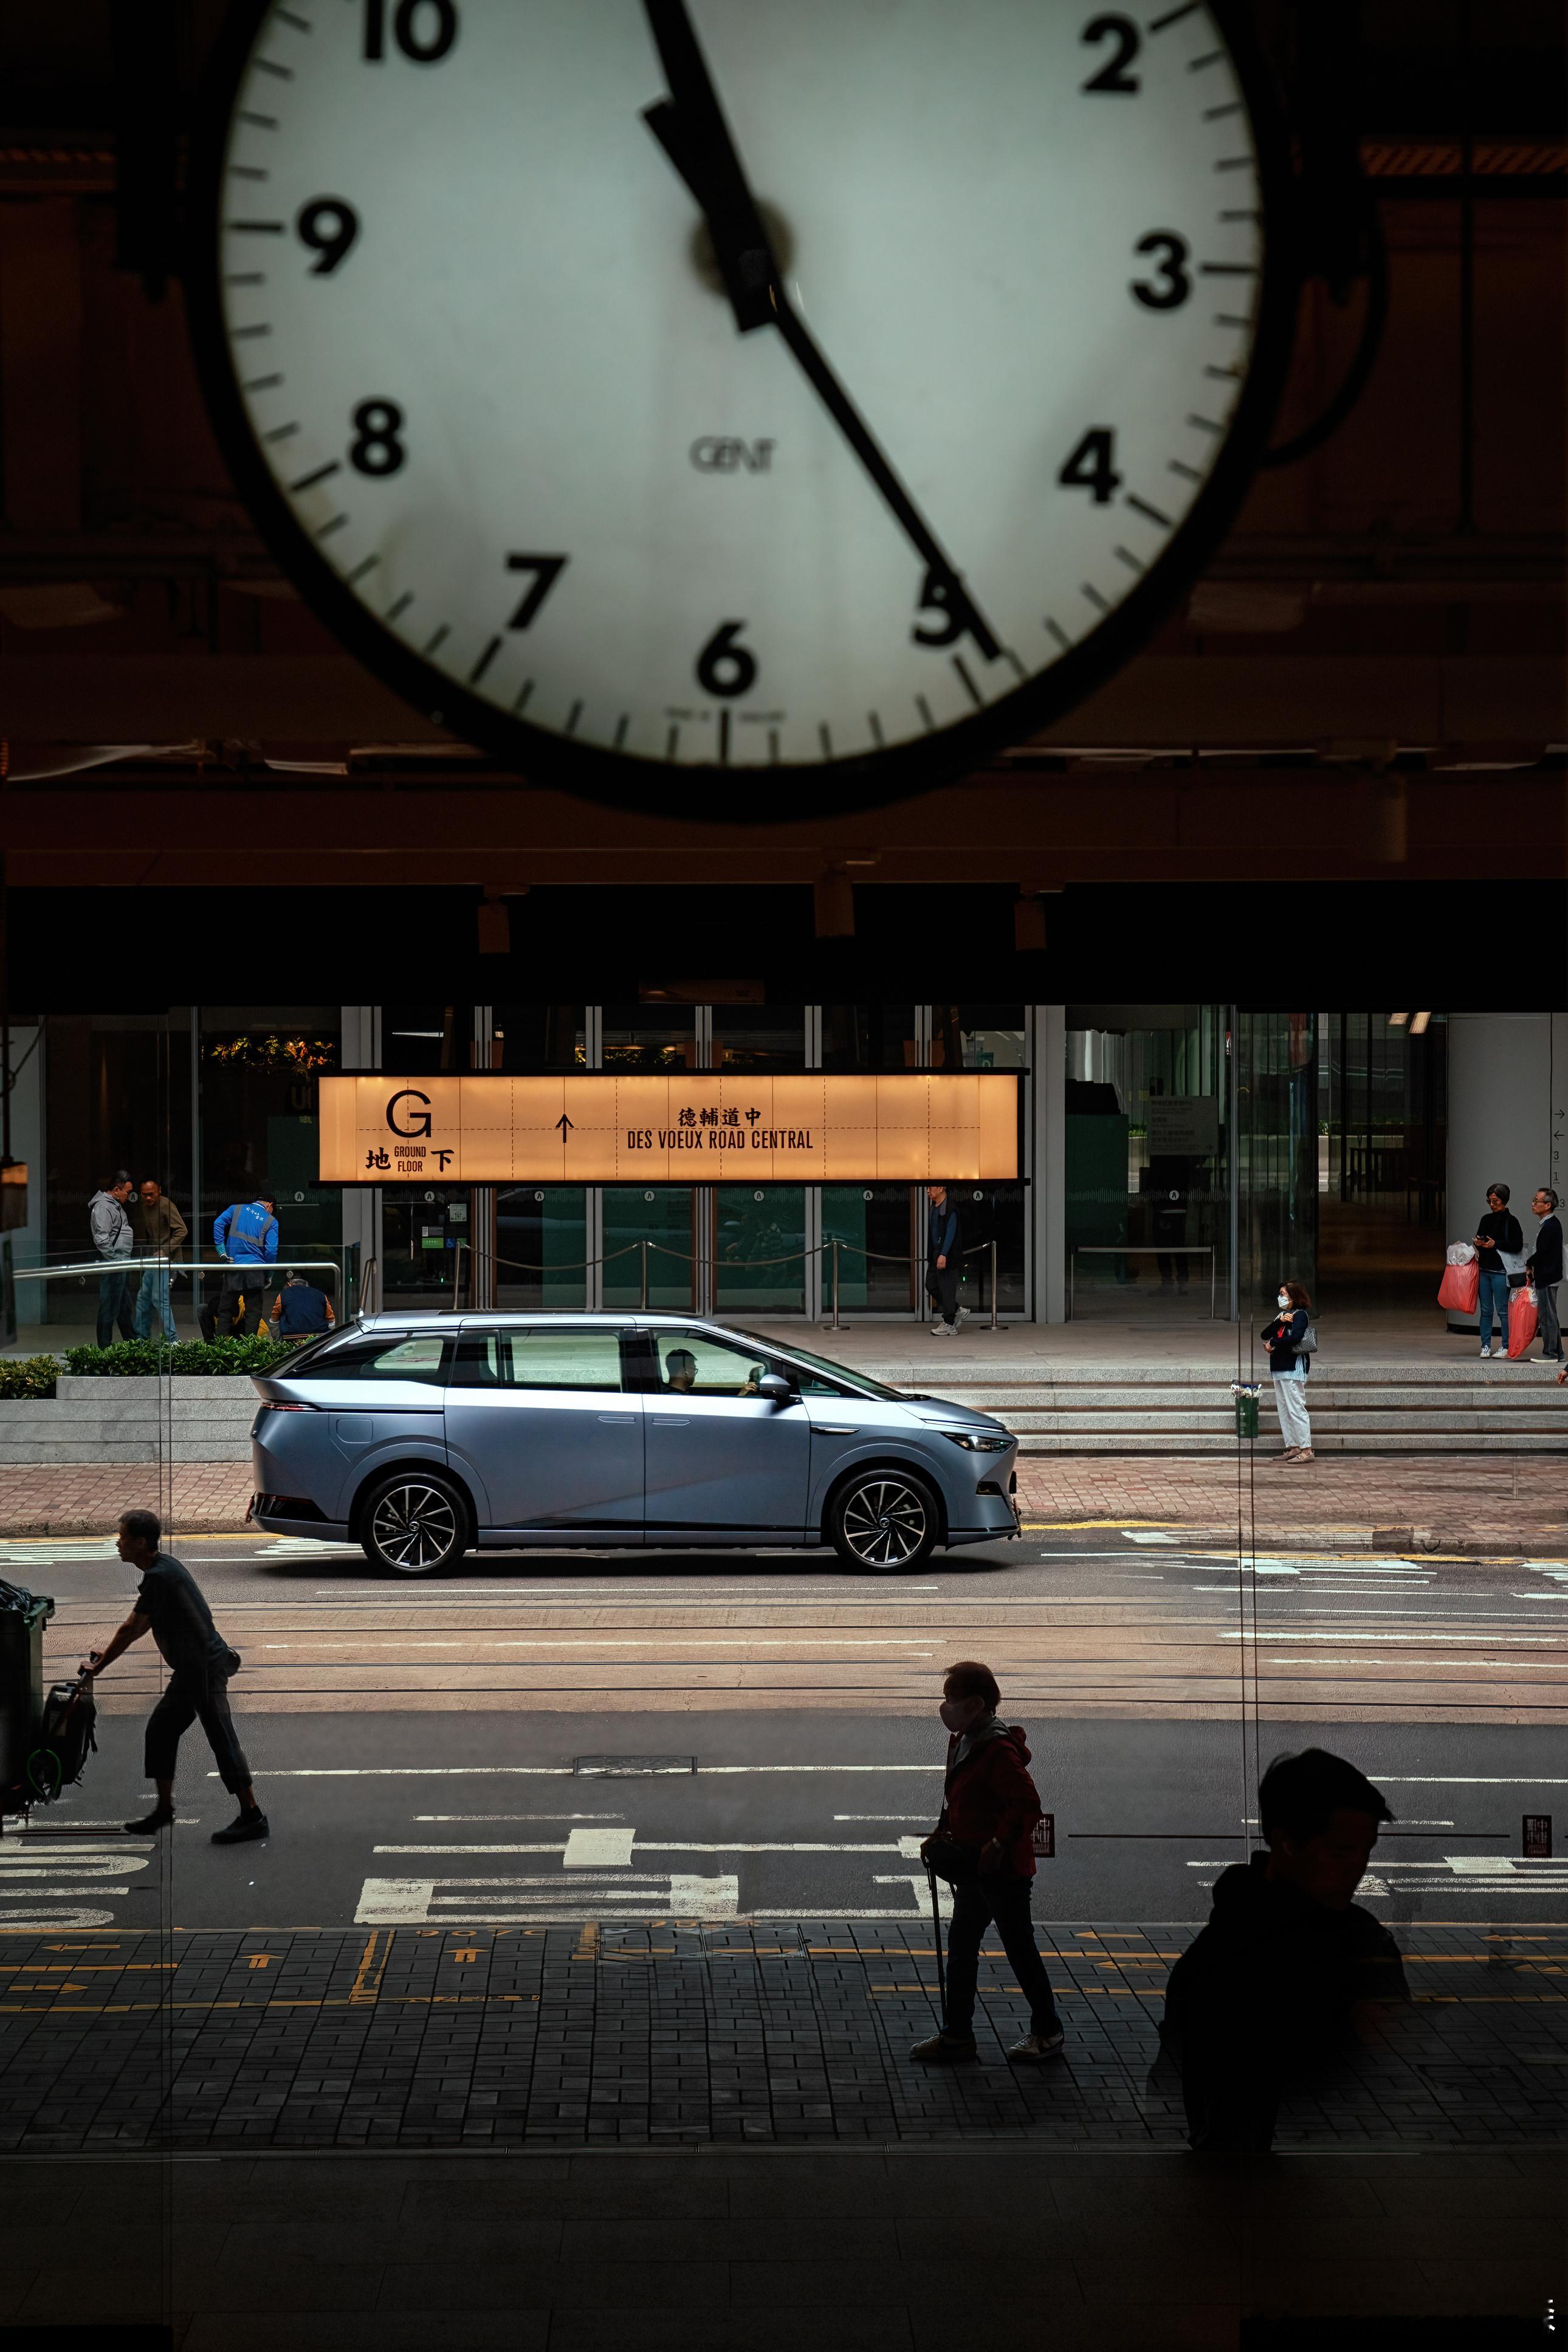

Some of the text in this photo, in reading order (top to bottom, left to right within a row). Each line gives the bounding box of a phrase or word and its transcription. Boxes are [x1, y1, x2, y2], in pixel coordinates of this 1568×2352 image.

[363, 0, 458, 64] 10
[1082, 12, 1142, 95] 2
[295, 197, 360, 275] 9
[1131, 230, 1192, 312] 3
[348, 399, 406, 479] 8
[1058, 427, 1122, 506] 4
[506, 554, 569, 632] 7
[912, 565, 968, 647] 5
[695, 621, 758, 700] 6
[386, 1089, 432, 1138] G
[628, 1130, 813, 1149] DES VOEUX ROAD CENTRAL
[677, 1107, 762, 1127] 德輔道中
[365, 1147, 455, 1172] 地 下
[394, 1146, 427, 1158] GROUND
[397, 1160, 423, 1172] FLOOR
[1553, 1150, 1559, 1160] 3
[1553, 1172, 1559, 1181] 1
